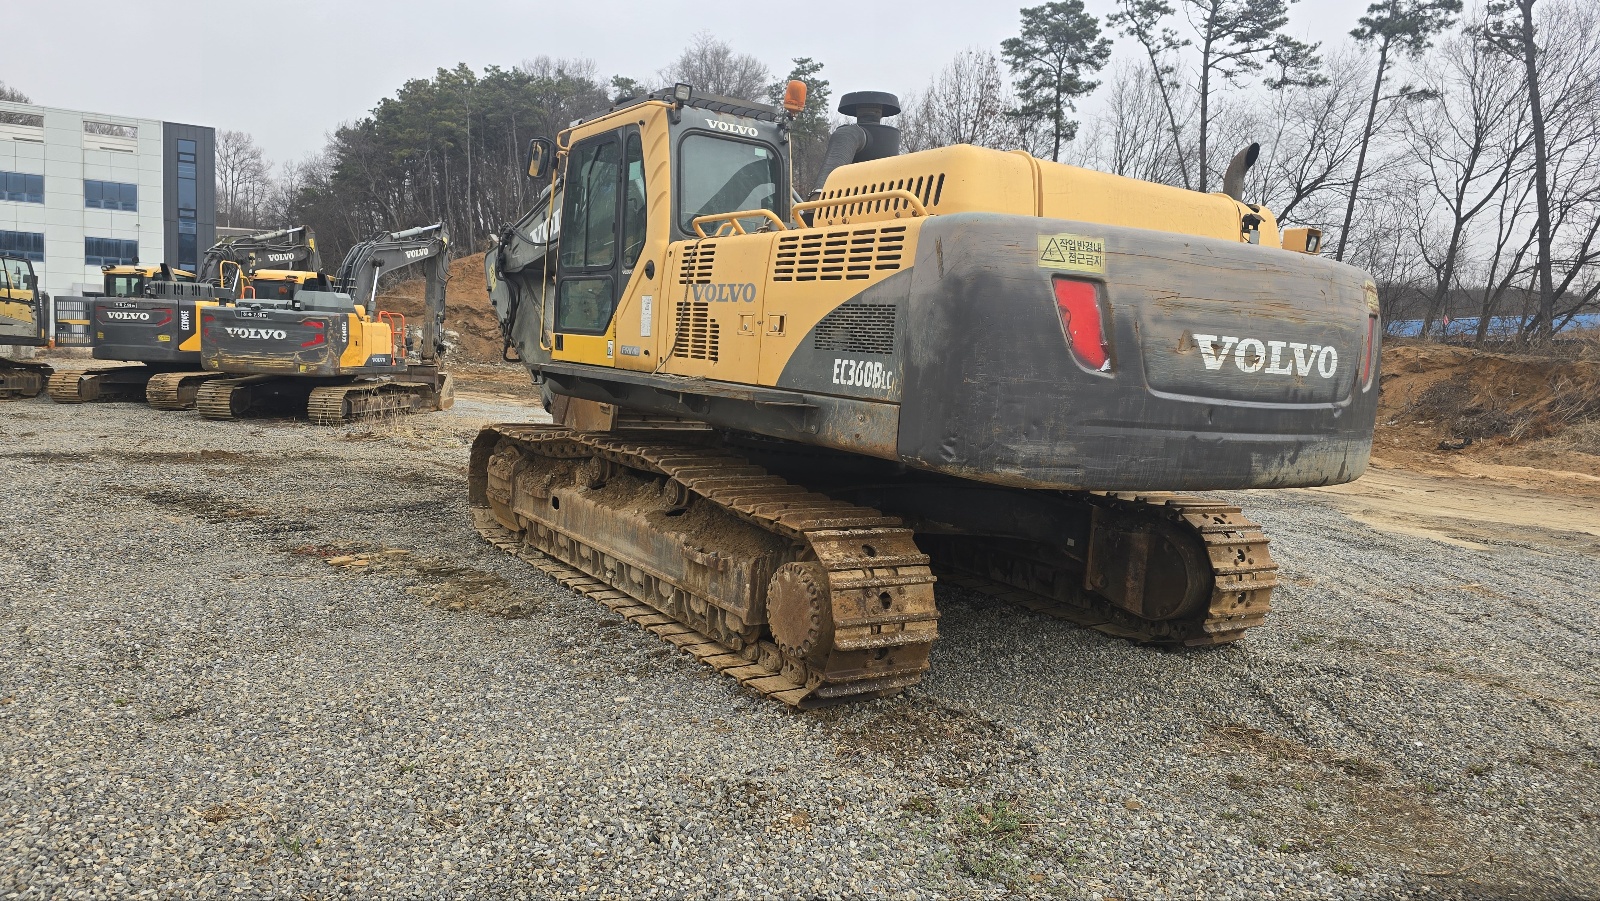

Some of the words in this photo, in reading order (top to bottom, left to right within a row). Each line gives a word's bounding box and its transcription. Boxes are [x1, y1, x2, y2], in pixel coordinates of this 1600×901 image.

[705, 118, 759, 137] VOLVO
[530, 207, 561, 249] VOL
[267, 253, 295, 263] VOLVO
[404, 247, 429, 259] VOLVO
[691, 283, 757, 303] VOLVO
[106, 311, 150, 321] VOLVO
[224, 327, 287, 340] VOLVO
[1192, 333, 1338, 379] VOLVO
